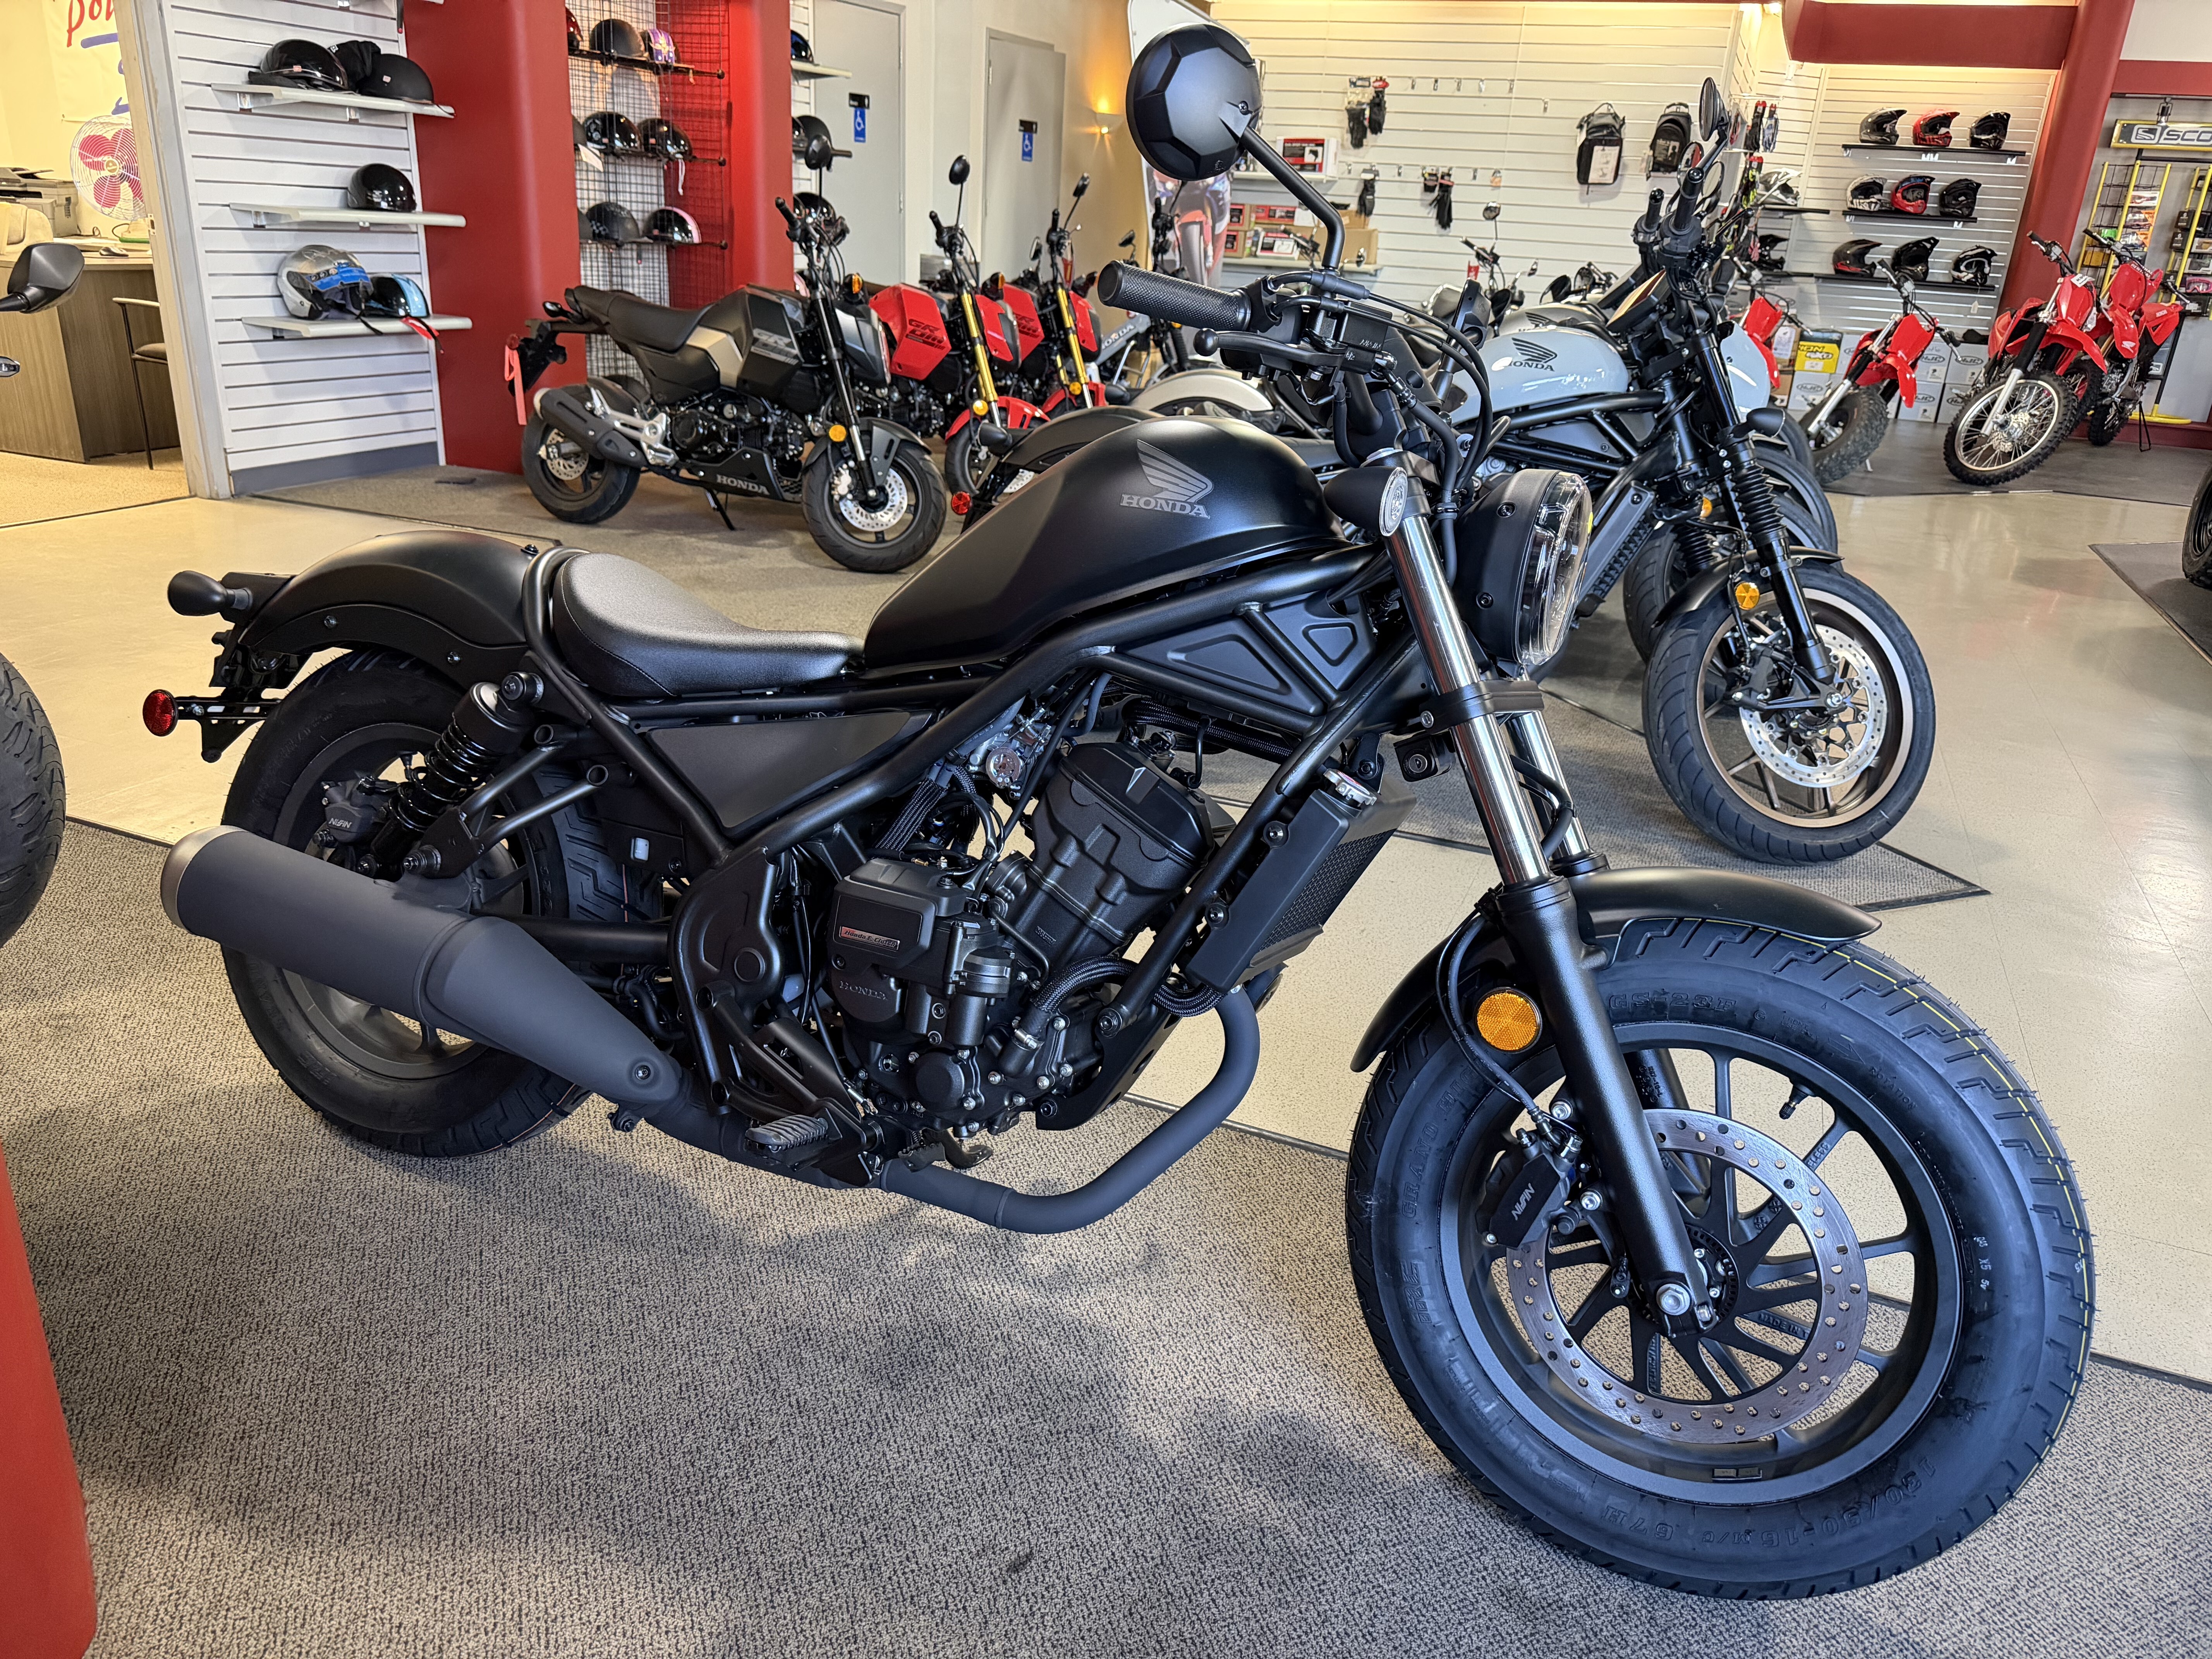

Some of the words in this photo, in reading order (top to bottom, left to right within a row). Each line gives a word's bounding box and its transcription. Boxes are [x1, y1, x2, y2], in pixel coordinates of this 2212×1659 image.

[716, 474, 770, 496] HONDA
[1120, 493, 1211, 520] HONDA
[328, 817, 352, 829] NISSIN
[843, 930, 867, 940] Honda
[839, 980, 888, 1001] HONDA
[1608, 990, 1737, 1012] GS-23F
[1869, 1065, 1918, 1110] ROTATION
[1401, 1122, 1439, 1219] GRAND
[1511, 1183, 1535, 1221] NISSIN
[1758, 1313, 1786, 1333] MADE
[1786, 1323, 1800, 1337] IN
[1602, 1504, 1674, 1541] 67H
